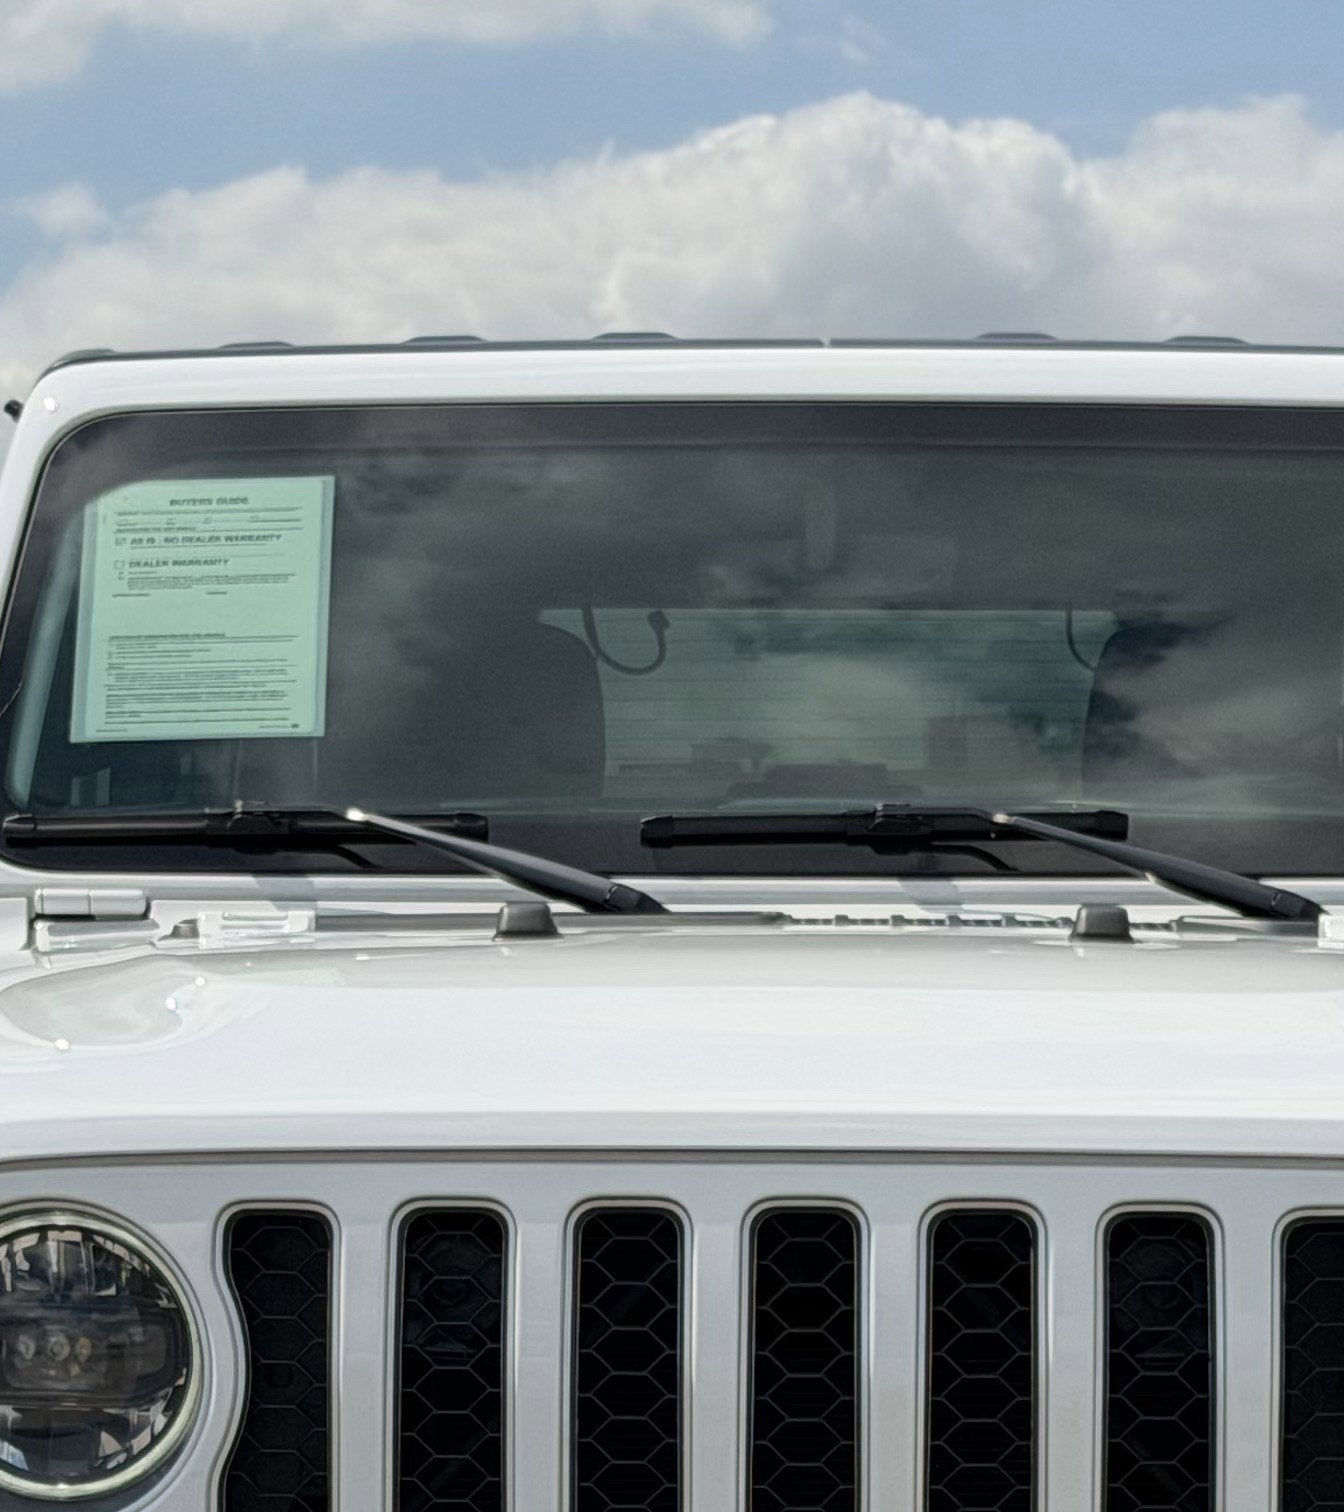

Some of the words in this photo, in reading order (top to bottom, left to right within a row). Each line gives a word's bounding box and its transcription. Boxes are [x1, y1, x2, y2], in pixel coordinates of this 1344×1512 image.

[181, 534, 222, 543] DEALER
[224, 533, 282, 542] WARRANTY
[128, 560, 171, 568] DEALER
